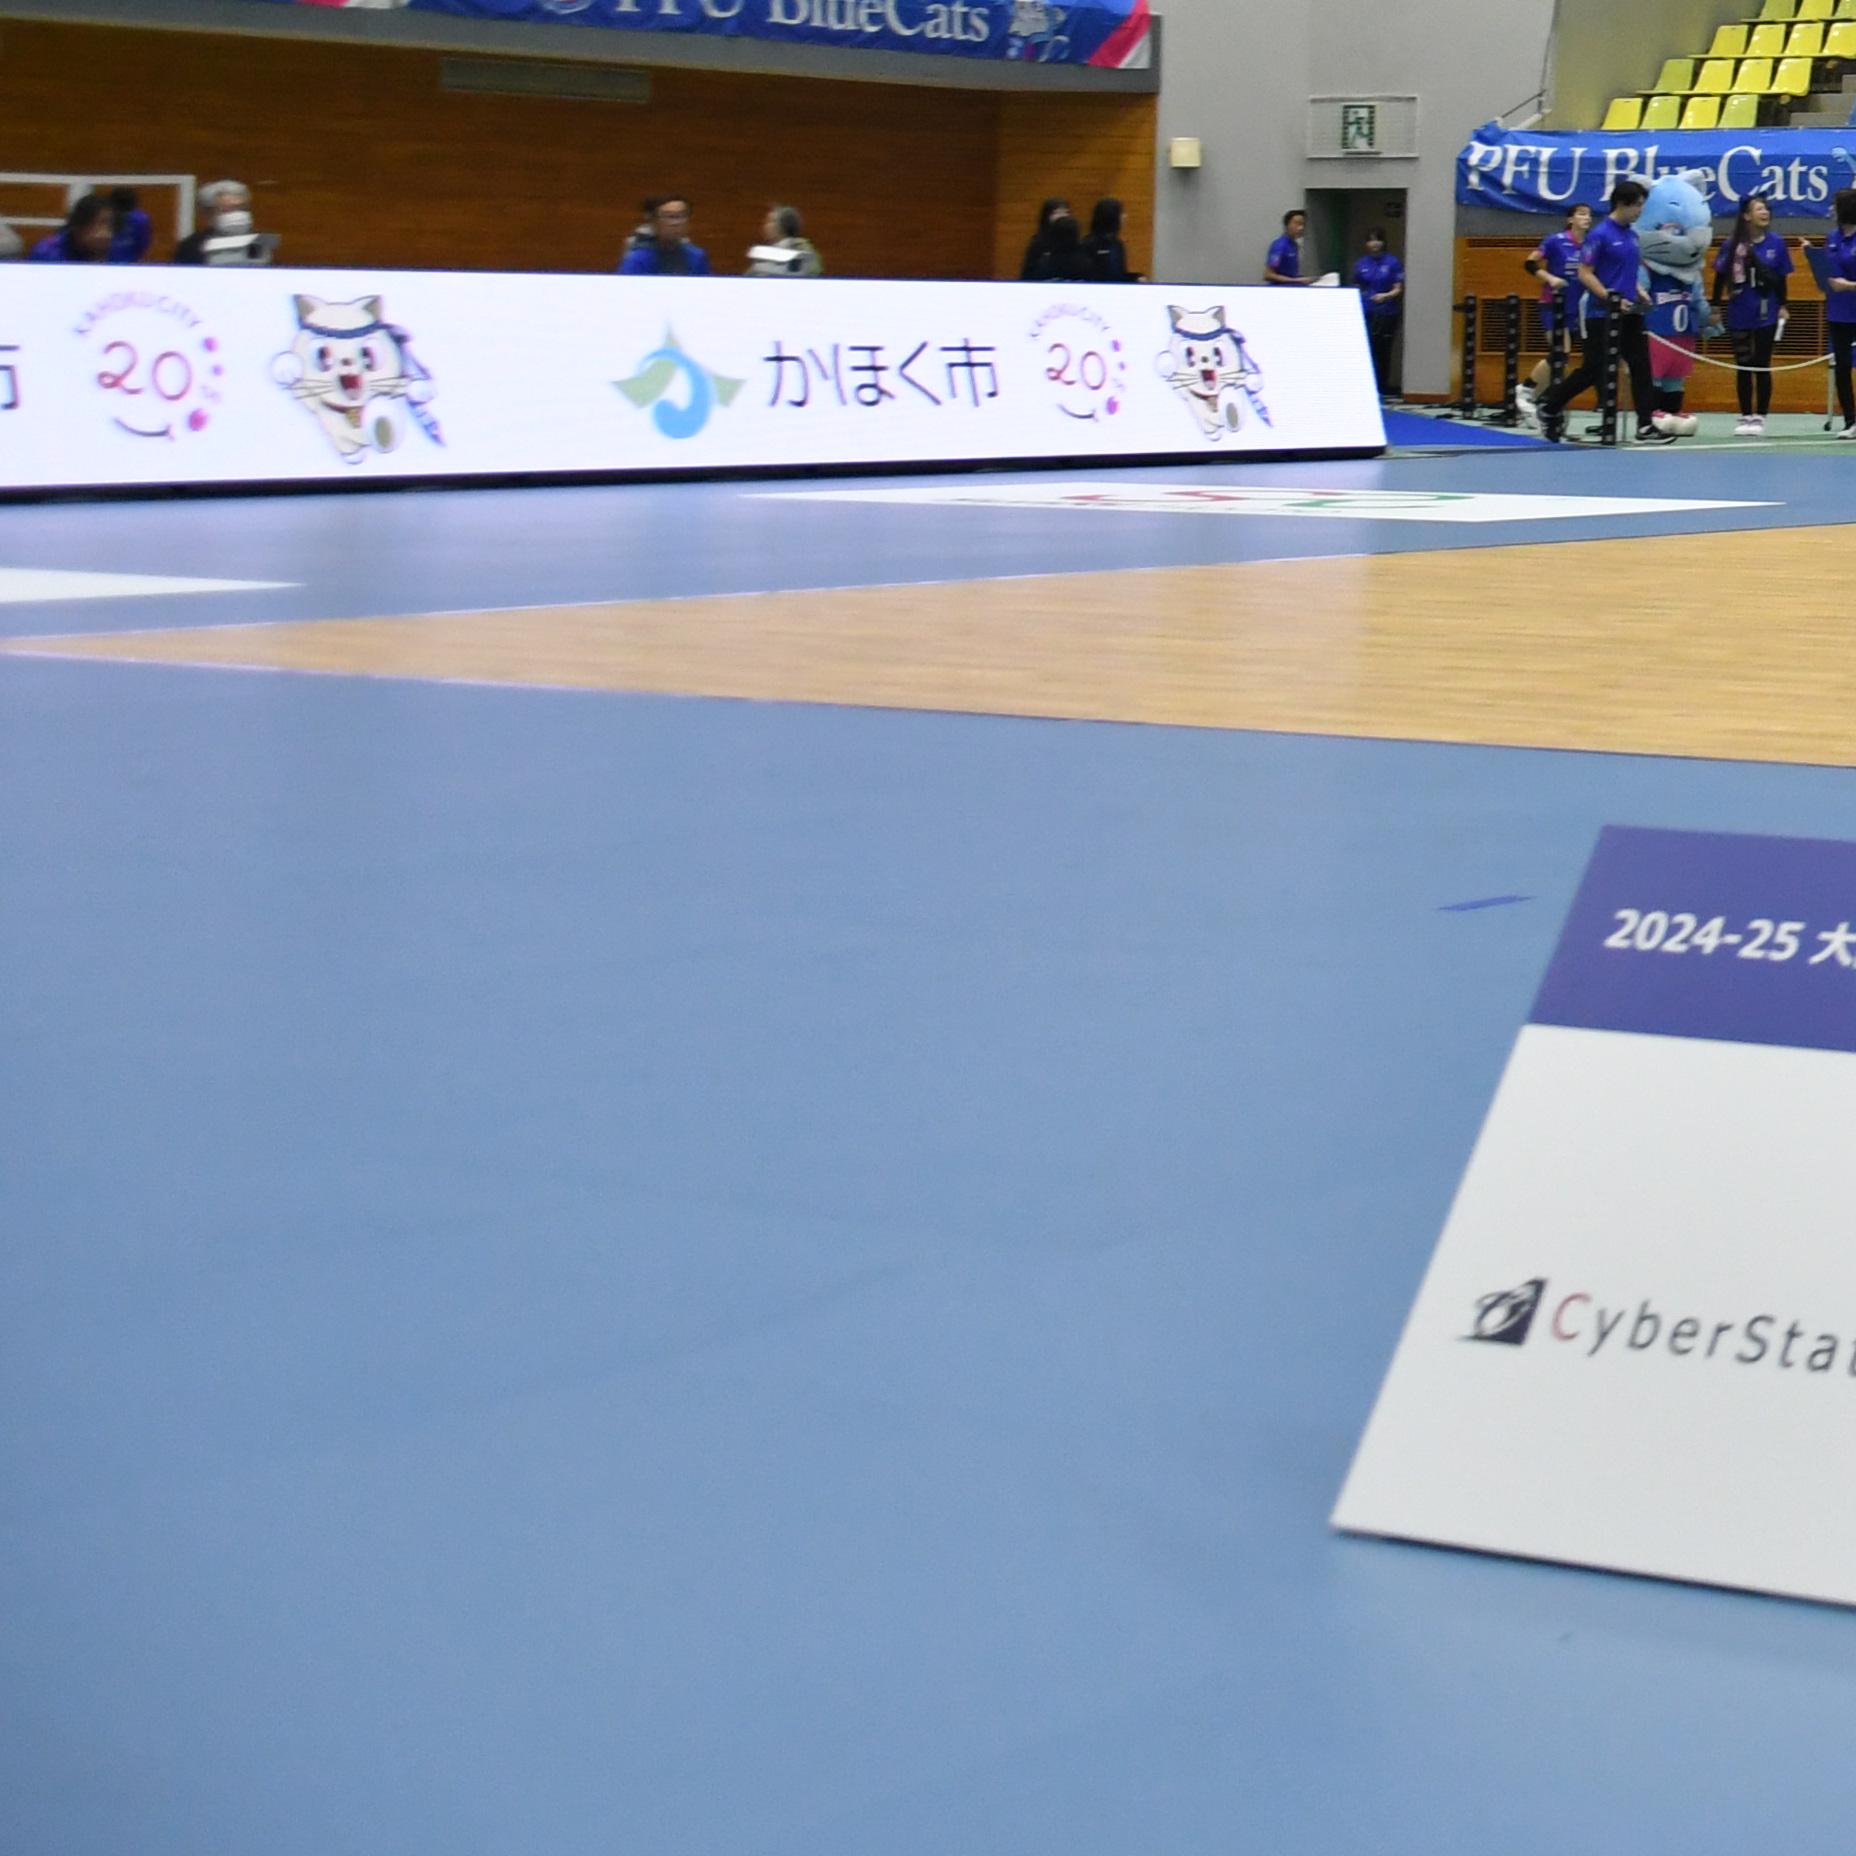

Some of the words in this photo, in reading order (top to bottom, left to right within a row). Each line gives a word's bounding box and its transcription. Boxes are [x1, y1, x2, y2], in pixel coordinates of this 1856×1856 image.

[1464, 140, 1588, 203] PFU
[1600, 144, 1829, 202] BleCats
[97, 341, 193, 401] 20
[763, 337, 999, 408] かほく市
[1046, 343, 1106, 390] 20
[1604, 908, 1806, 962] 2024-25
